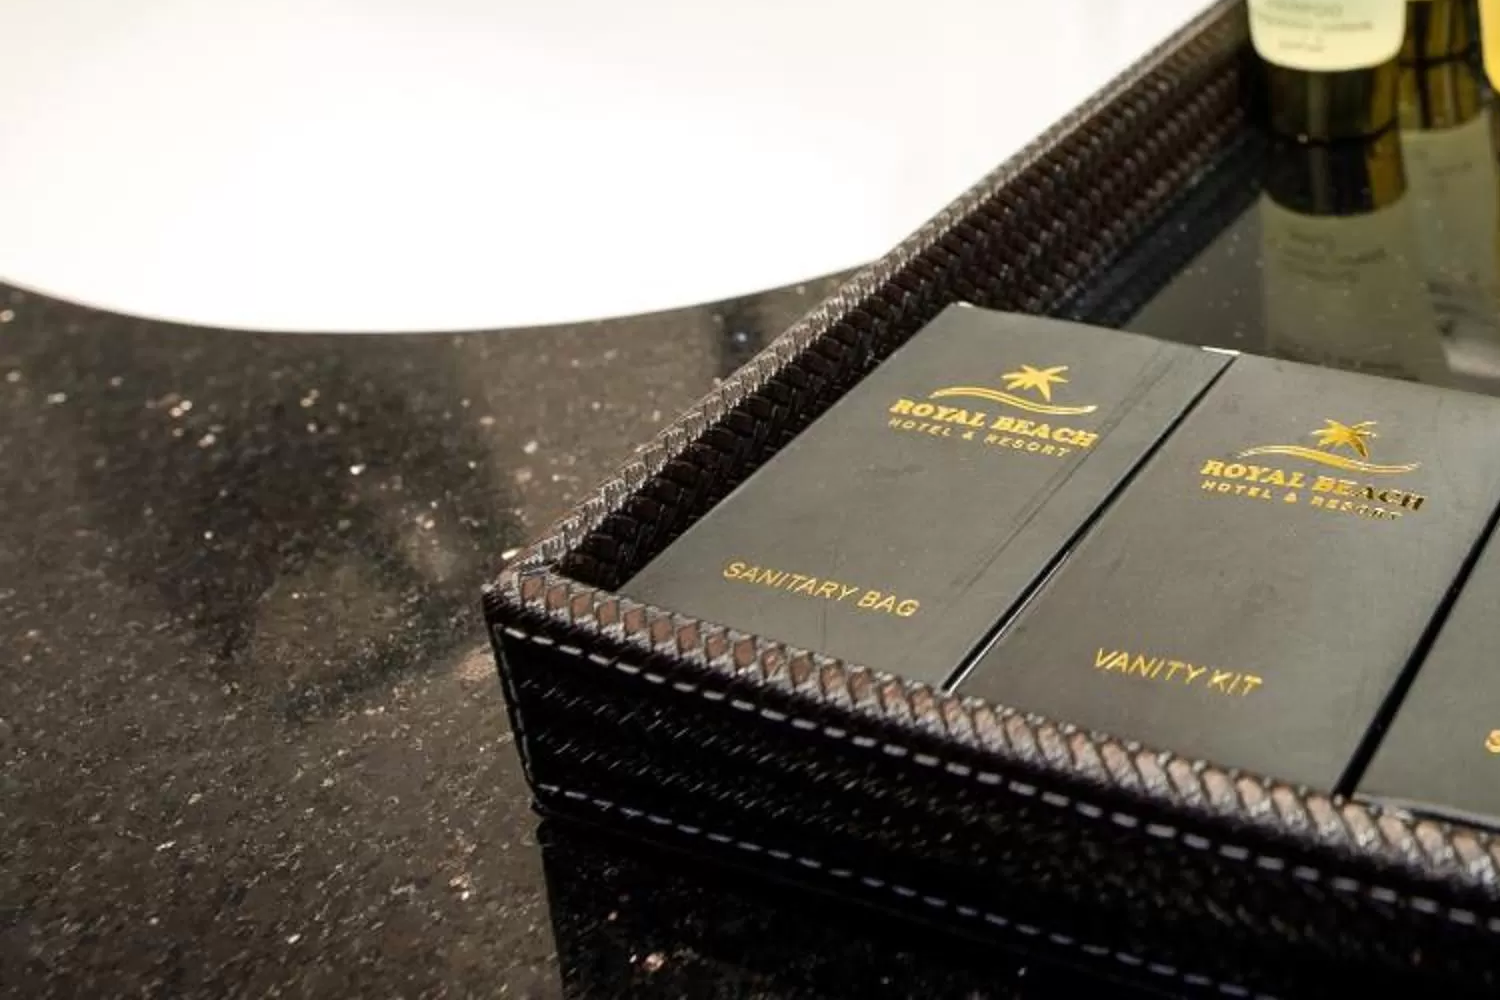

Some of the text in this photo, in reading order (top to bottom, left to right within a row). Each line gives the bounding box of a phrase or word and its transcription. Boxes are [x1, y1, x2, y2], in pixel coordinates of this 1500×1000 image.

[888, 417, 951, 437] HOTEL
[984, 433, 1071, 457] RESORT
[889, 399, 1099, 448] ROYAL BEACH
[1200, 459, 1427, 512] ROYAL BEACH
[1201, 479, 1273, 500] HOTEL
[1310, 495, 1403, 521] RESORT
[723, 561, 920, 617] SANITARY BAG
[1095, 647, 1263, 697] VANITY KIT
